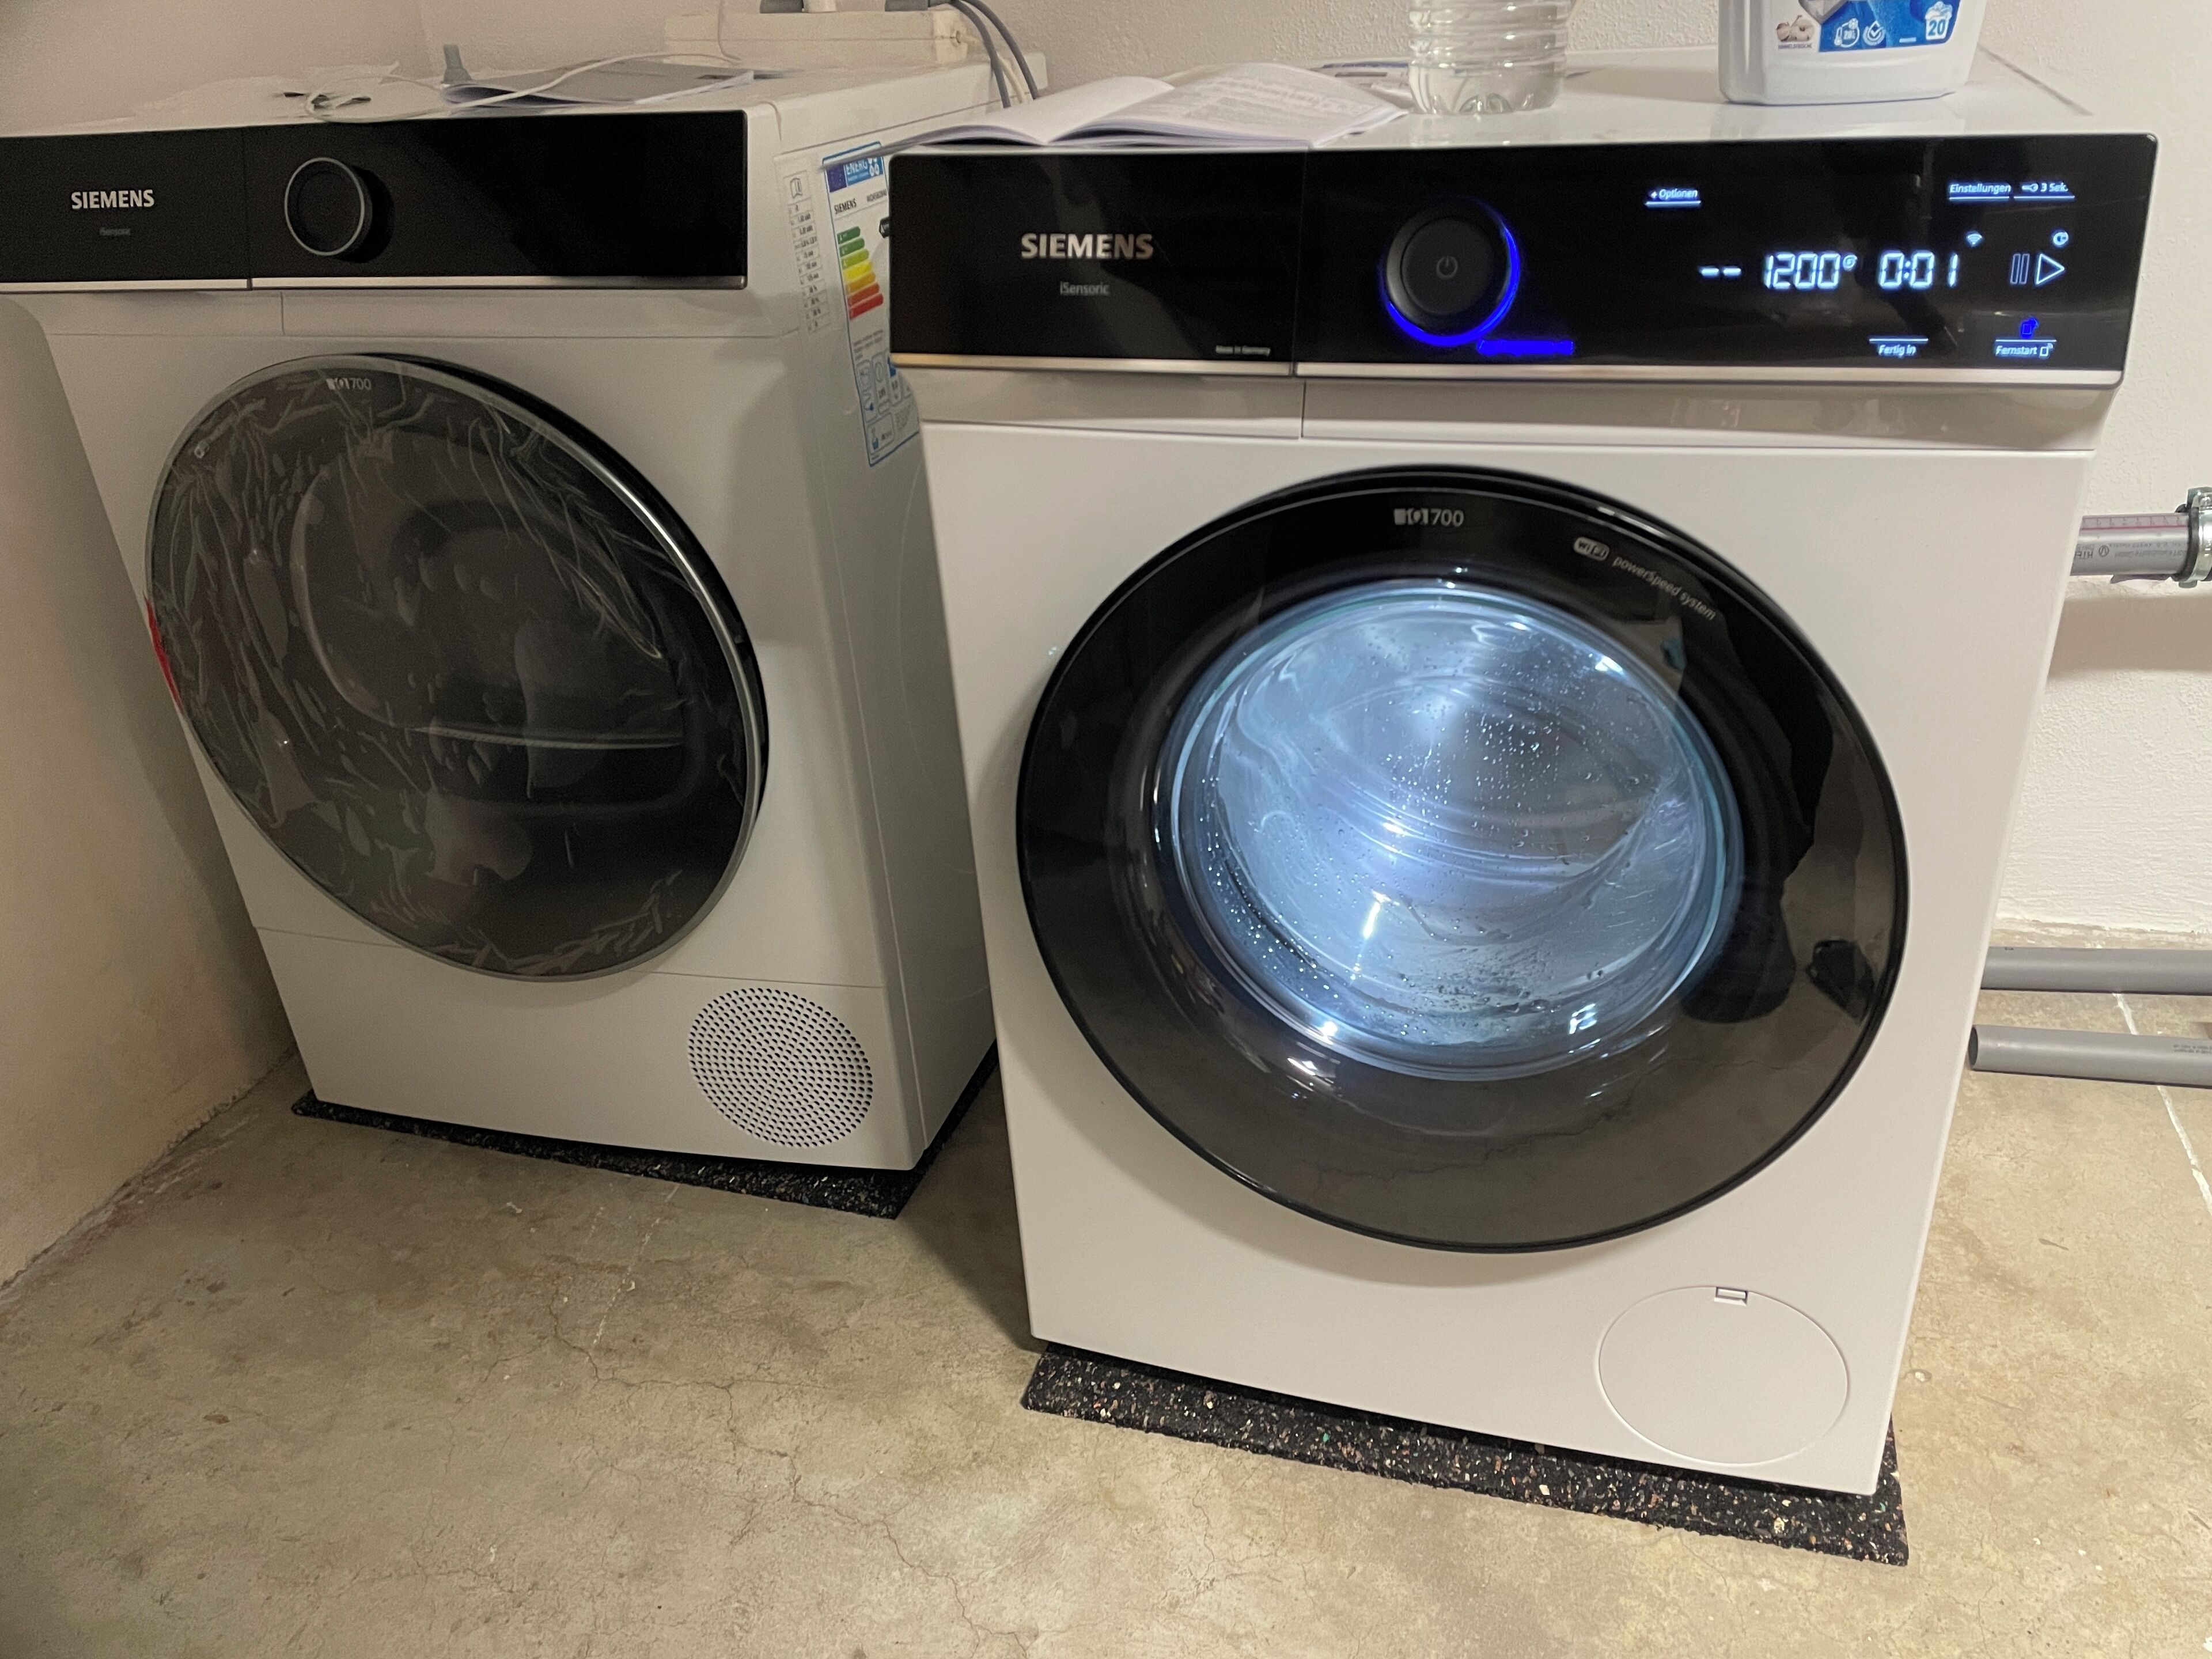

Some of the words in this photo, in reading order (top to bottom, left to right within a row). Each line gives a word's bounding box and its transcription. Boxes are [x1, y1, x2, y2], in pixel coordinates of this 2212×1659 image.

[1929, 20, 1945, 36] 20
[1659, 188, 1698, 200] Optionen
[1950, 183, 2011, 195] Einstellungen
[2040, 183, 2047, 192] 3
[71, 189, 155, 209] SIEMENS
[834, 198, 857, 214] SIEMENS
[1021, 233, 1154, 259] SIEMENS
[1764, 252, 1842, 288] 1200
[1060, 281, 1111, 296] iSensoric
[1878, 345, 1905, 358] Fertig
[1906, 345, 1917, 355] in
[1995, 346, 2037, 356] Fernstart
[1679, 592, 1717, 620] system
